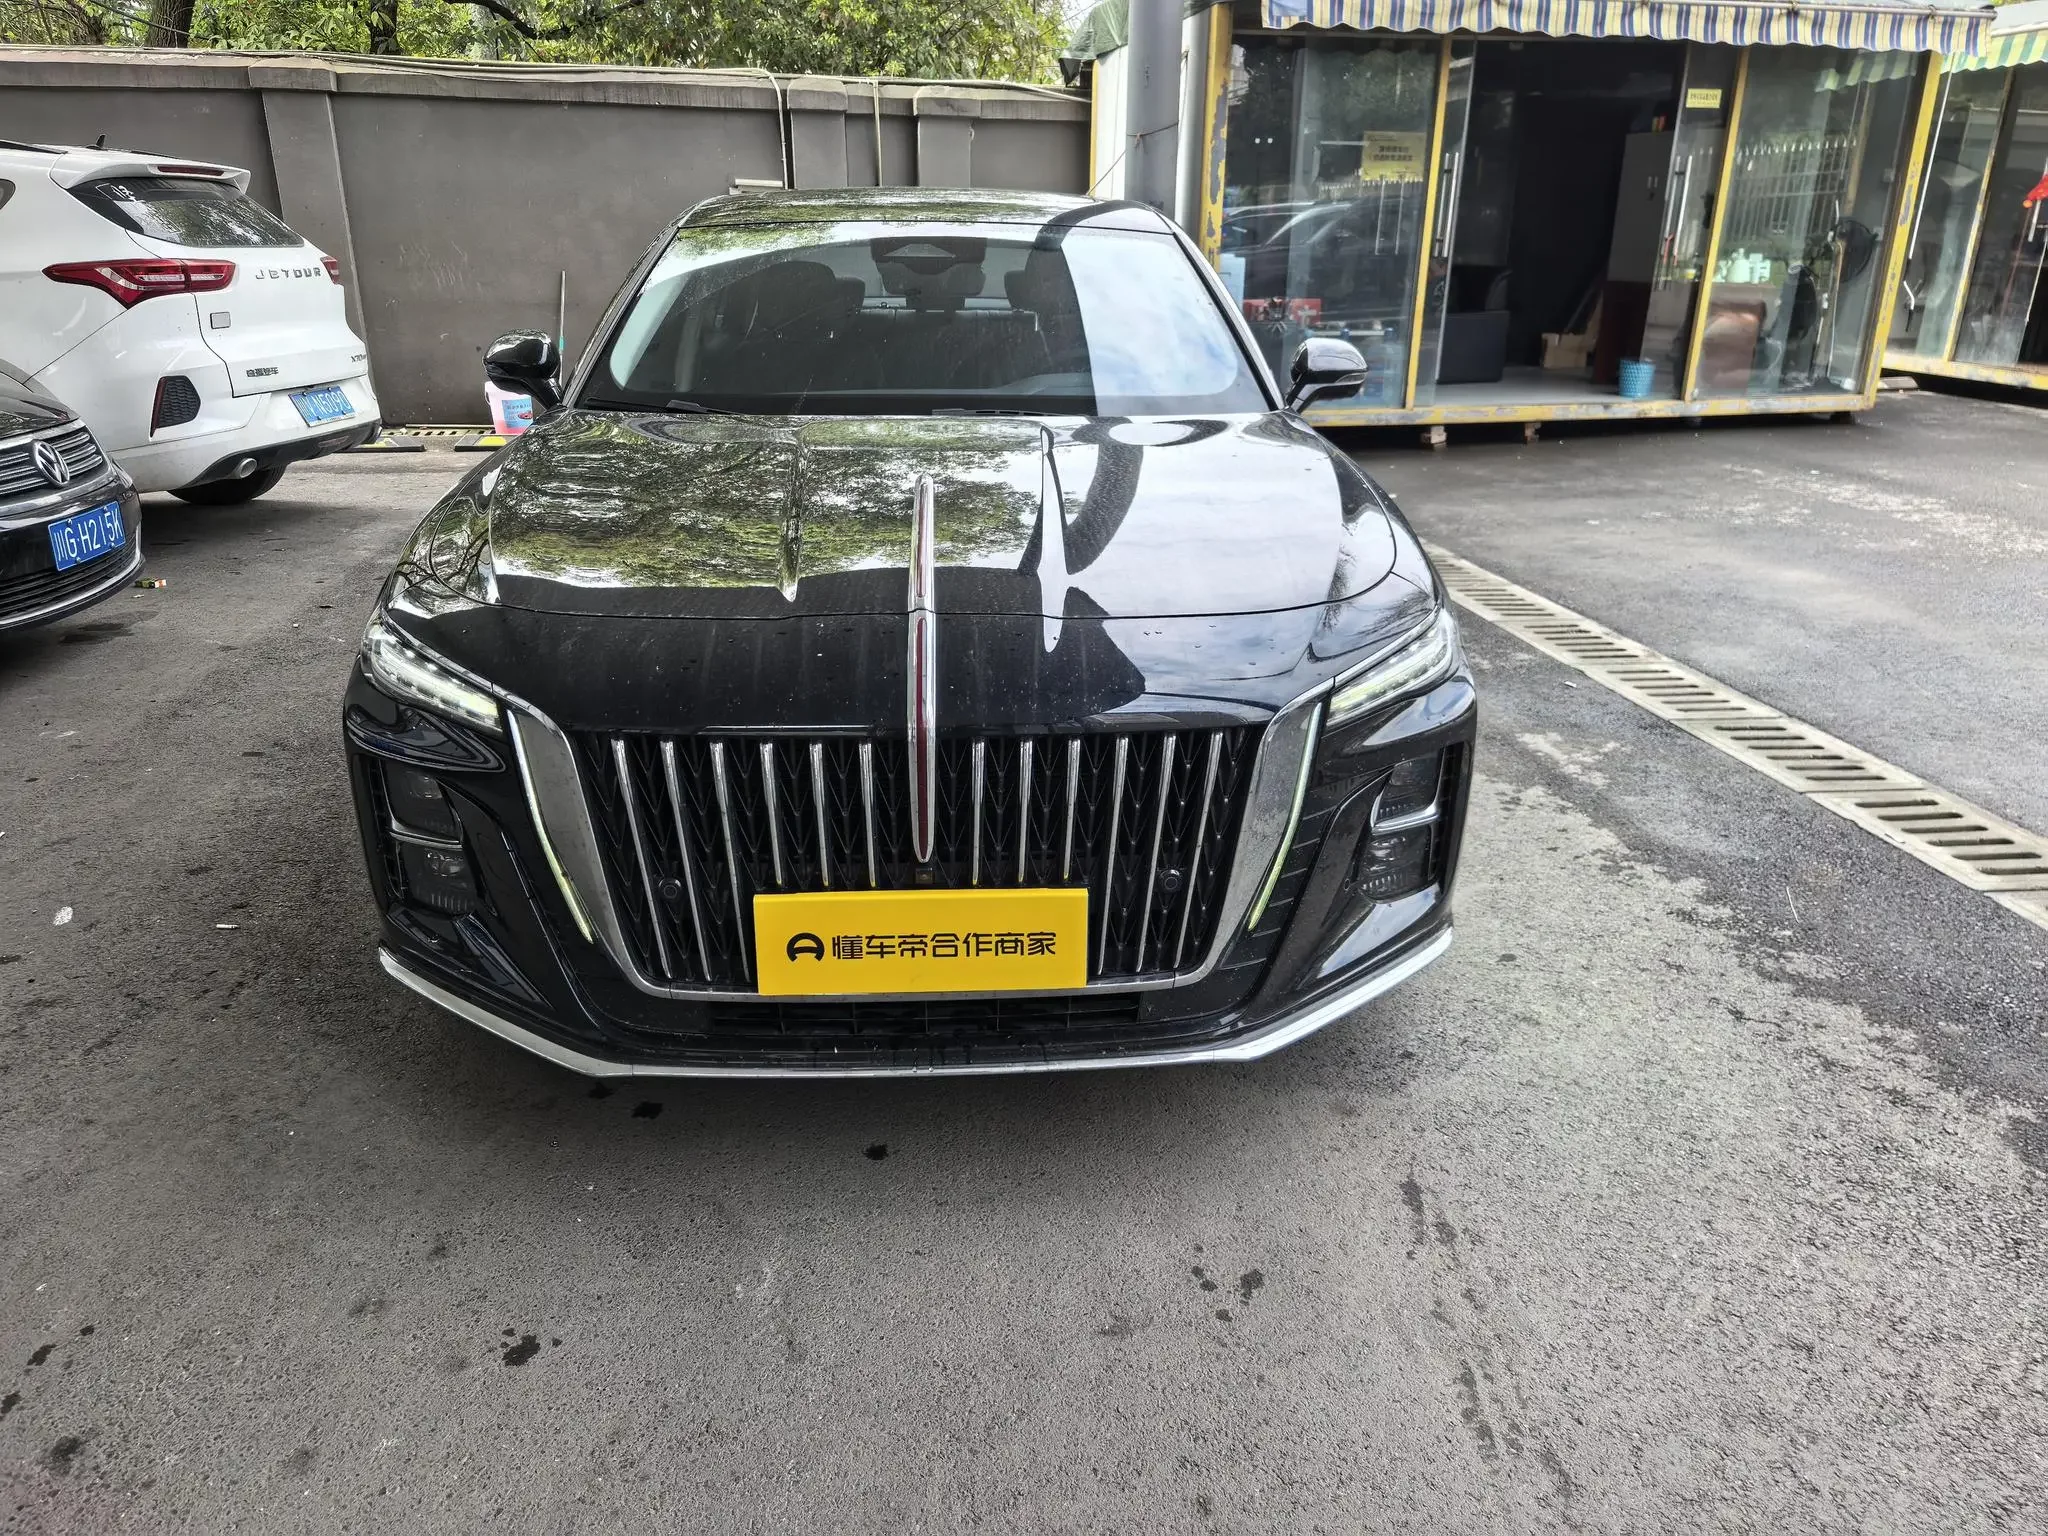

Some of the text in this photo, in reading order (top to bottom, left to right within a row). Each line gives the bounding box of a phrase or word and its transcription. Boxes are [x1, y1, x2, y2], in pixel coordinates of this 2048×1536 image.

[255, 267, 322, 280] JETOUR
[832, 931, 1056, 960] 懂车帝合作商家
